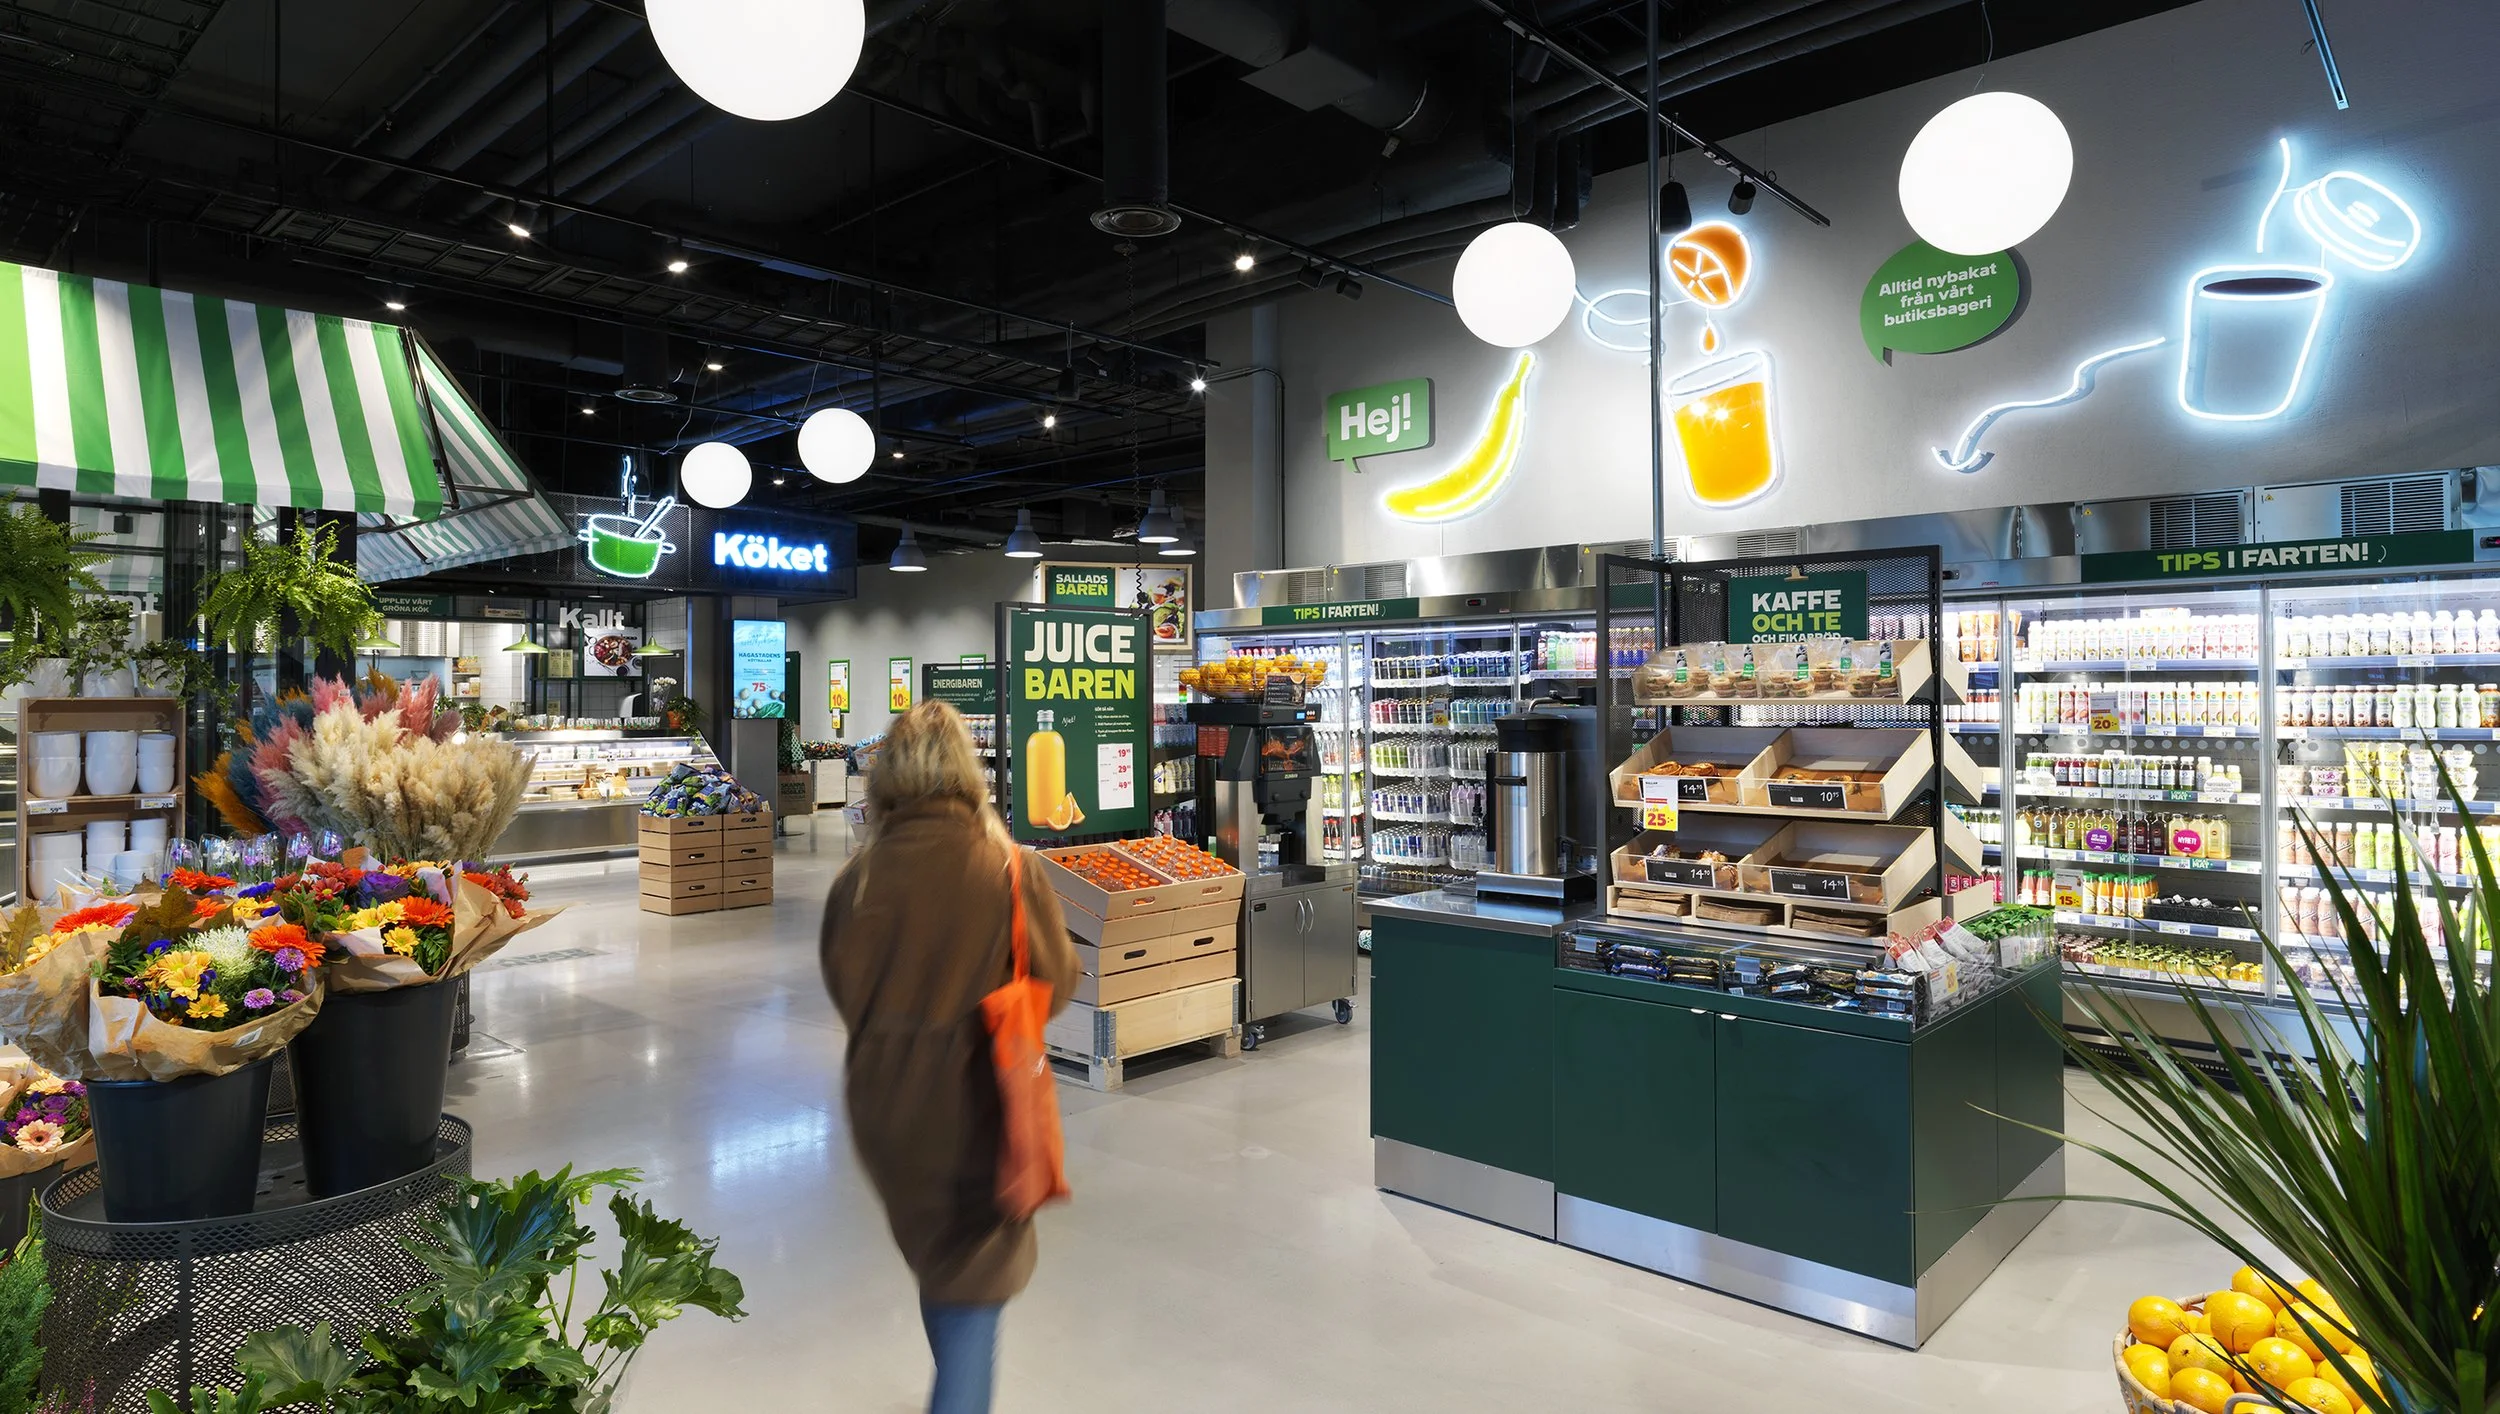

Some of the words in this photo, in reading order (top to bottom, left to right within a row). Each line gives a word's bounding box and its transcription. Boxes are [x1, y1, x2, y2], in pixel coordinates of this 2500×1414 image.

[1879, 277, 1922, 296] Alltid
[1926, 263, 1997, 288] nybakat
[1901, 292, 1934, 308] från
[1938, 284, 1974, 301] vårt
[1884, 295, 1992, 326] butiksbageri
[1340, 392, 1411, 443] Hej!
[714, 532, 828, 573] Köket
[2157, 551, 2221, 572] TIPS
[2228, 550, 2235, 569] I
[2242, 542, 2369, 568] FARTEN!
[1055, 573, 1108, 584] SALLADS
[1055, 583, 1108, 596] BAREN
[1293, 607, 1320, 620] TIPS
[1322, 606, 1326, 618] I
[1328, 603, 1379, 618] FARTEN!
[1752, 589, 1841, 612] KAFFE
[559, 606, 625, 631] Kallt
[1752, 613, 1803, 632] OCH
[1808, 611, 1841, 631] TE
[1024, 620, 1135, 663] JUICE
[1752, 634, 1776, 643] OCH
[932, 678, 983, 689] ENERGIBAREN
[1024, 668, 1135, 700] BAREN
[1647, 812, 1674, 827] 25:-
